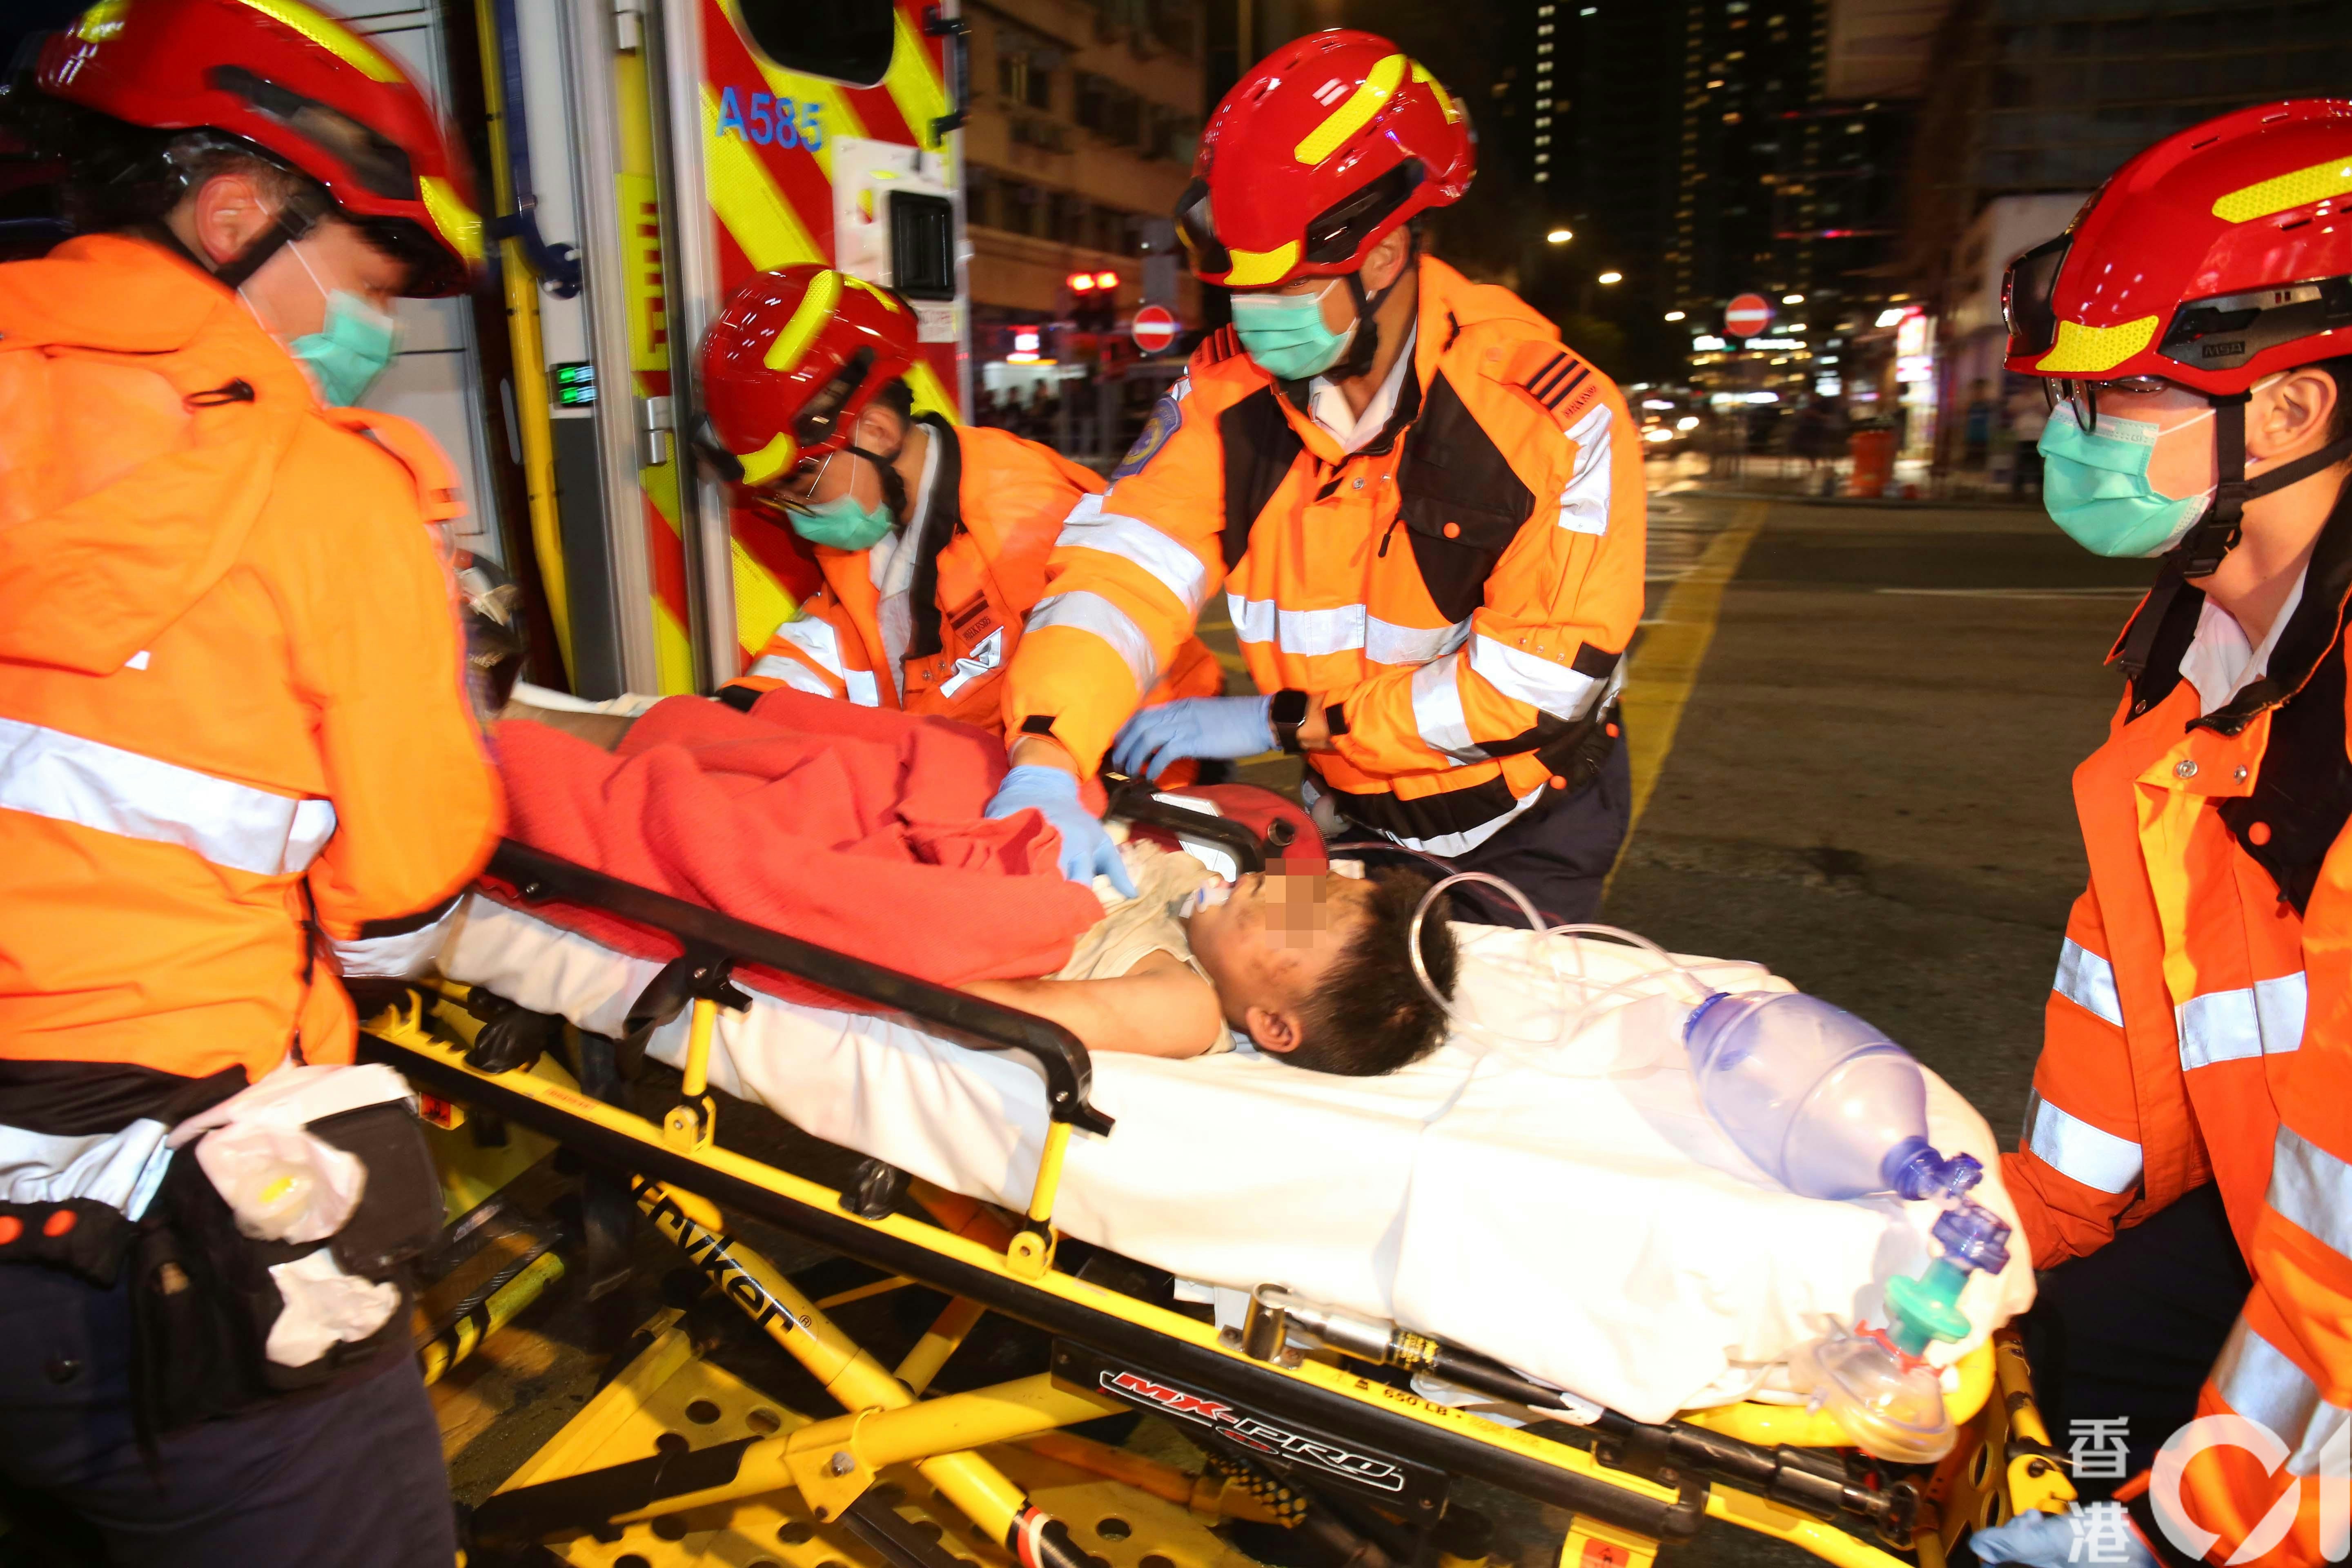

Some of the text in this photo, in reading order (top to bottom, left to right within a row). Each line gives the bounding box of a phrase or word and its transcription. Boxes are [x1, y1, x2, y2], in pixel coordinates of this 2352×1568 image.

[715, 86, 822, 152] A585
[2205, 343, 2243, 356] MSA
[1111, 1371, 1397, 1477] MX-PRO
[1384, 1389, 1447, 1416] 650 LB
